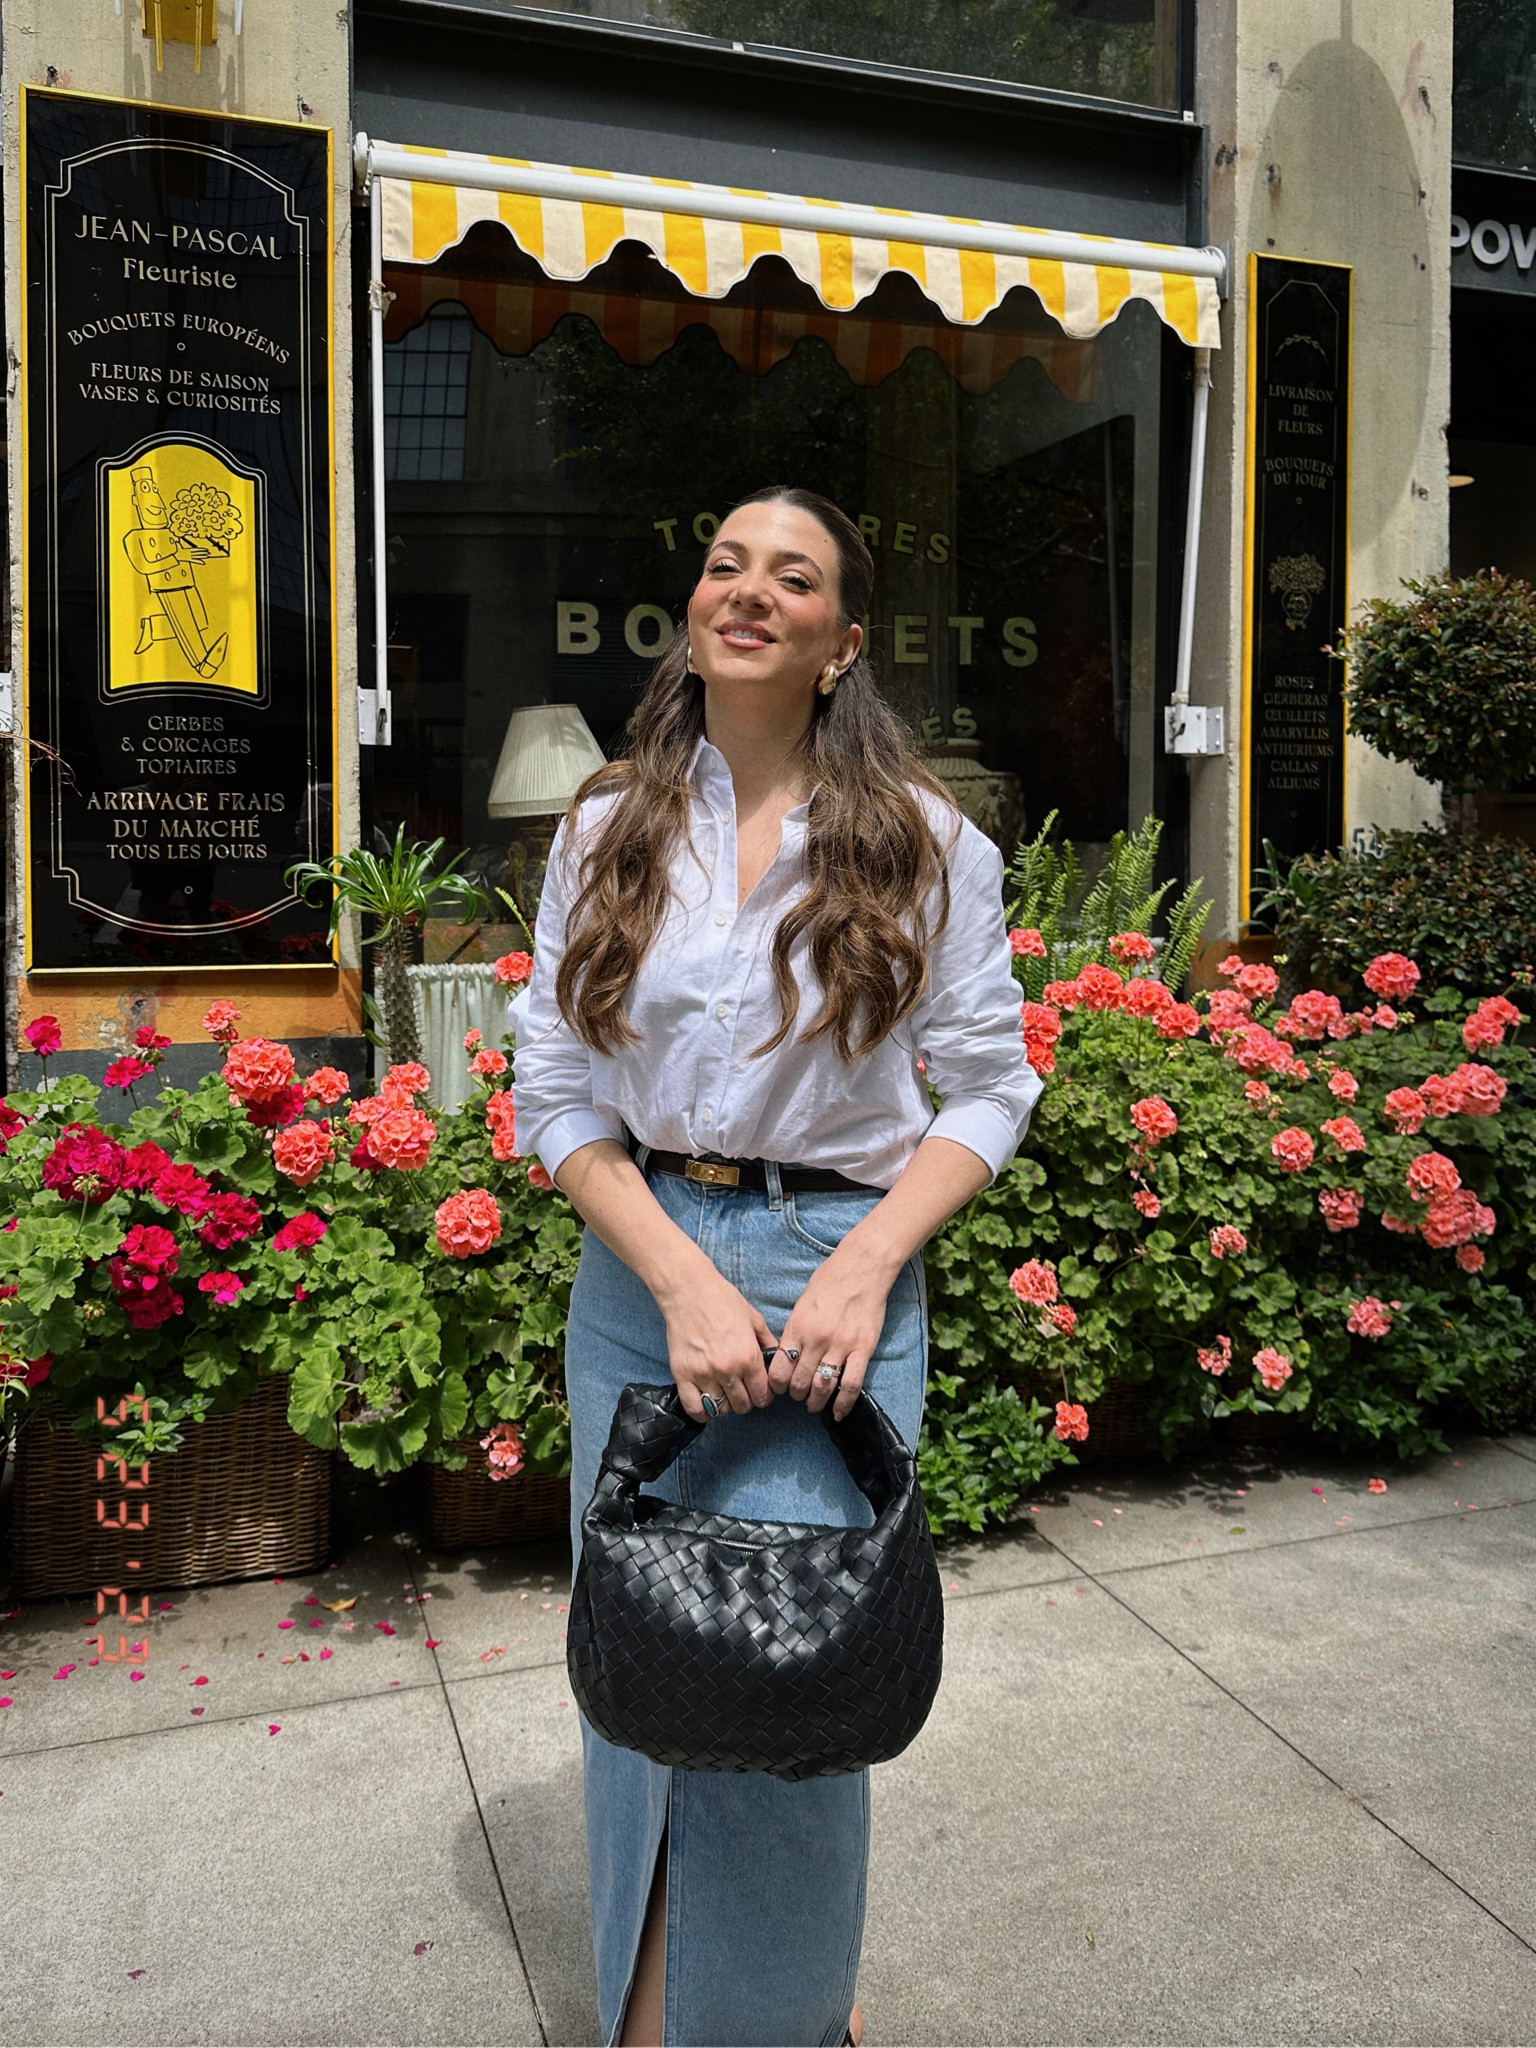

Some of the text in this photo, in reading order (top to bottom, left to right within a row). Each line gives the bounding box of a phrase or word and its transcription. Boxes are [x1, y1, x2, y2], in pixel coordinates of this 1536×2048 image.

[75, 215, 282, 260] JEAN-PASCAL
[123, 258, 238, 290] Fleuriste
[67, 312, 290, 364] BOUQUETS EUROPÉENS
[91, 363, 270, 393] FLEURS DE SAISON
[79, 384, 281, 415] VASES & CURIOSITÉS
[1269, 384, 1334, 403] LIVRAISON
[1293, 404, 1309, 418] DE
[1278, 420, 1323, 436] FLEURS
[1265, 457, 1335, 477] BOUQUETS
[1273, 473, 1291, 486] DU
[1275, 675, 1314, 689] ROSES
[148, 715, 224, 731] GERBES
[1261, 726, 1330, 740] AMARYLLIS
[121, 737, 251, 754] & CORCAGES
[1255, 743, 1334, 758] ANTHURIUMS
[136, 758, 237, 774] TOPIAIRES
[1270, 760, 1319, 773] CALLAS
[1268, 777, 1321, 790] ALLIUMS
[86, 791, 286, 812] ARRIVAGE FRAIS
[114, 814, 260, 838] DU MARCHÉ
[106, 844, 267, 861] TOUS LES JOURS
